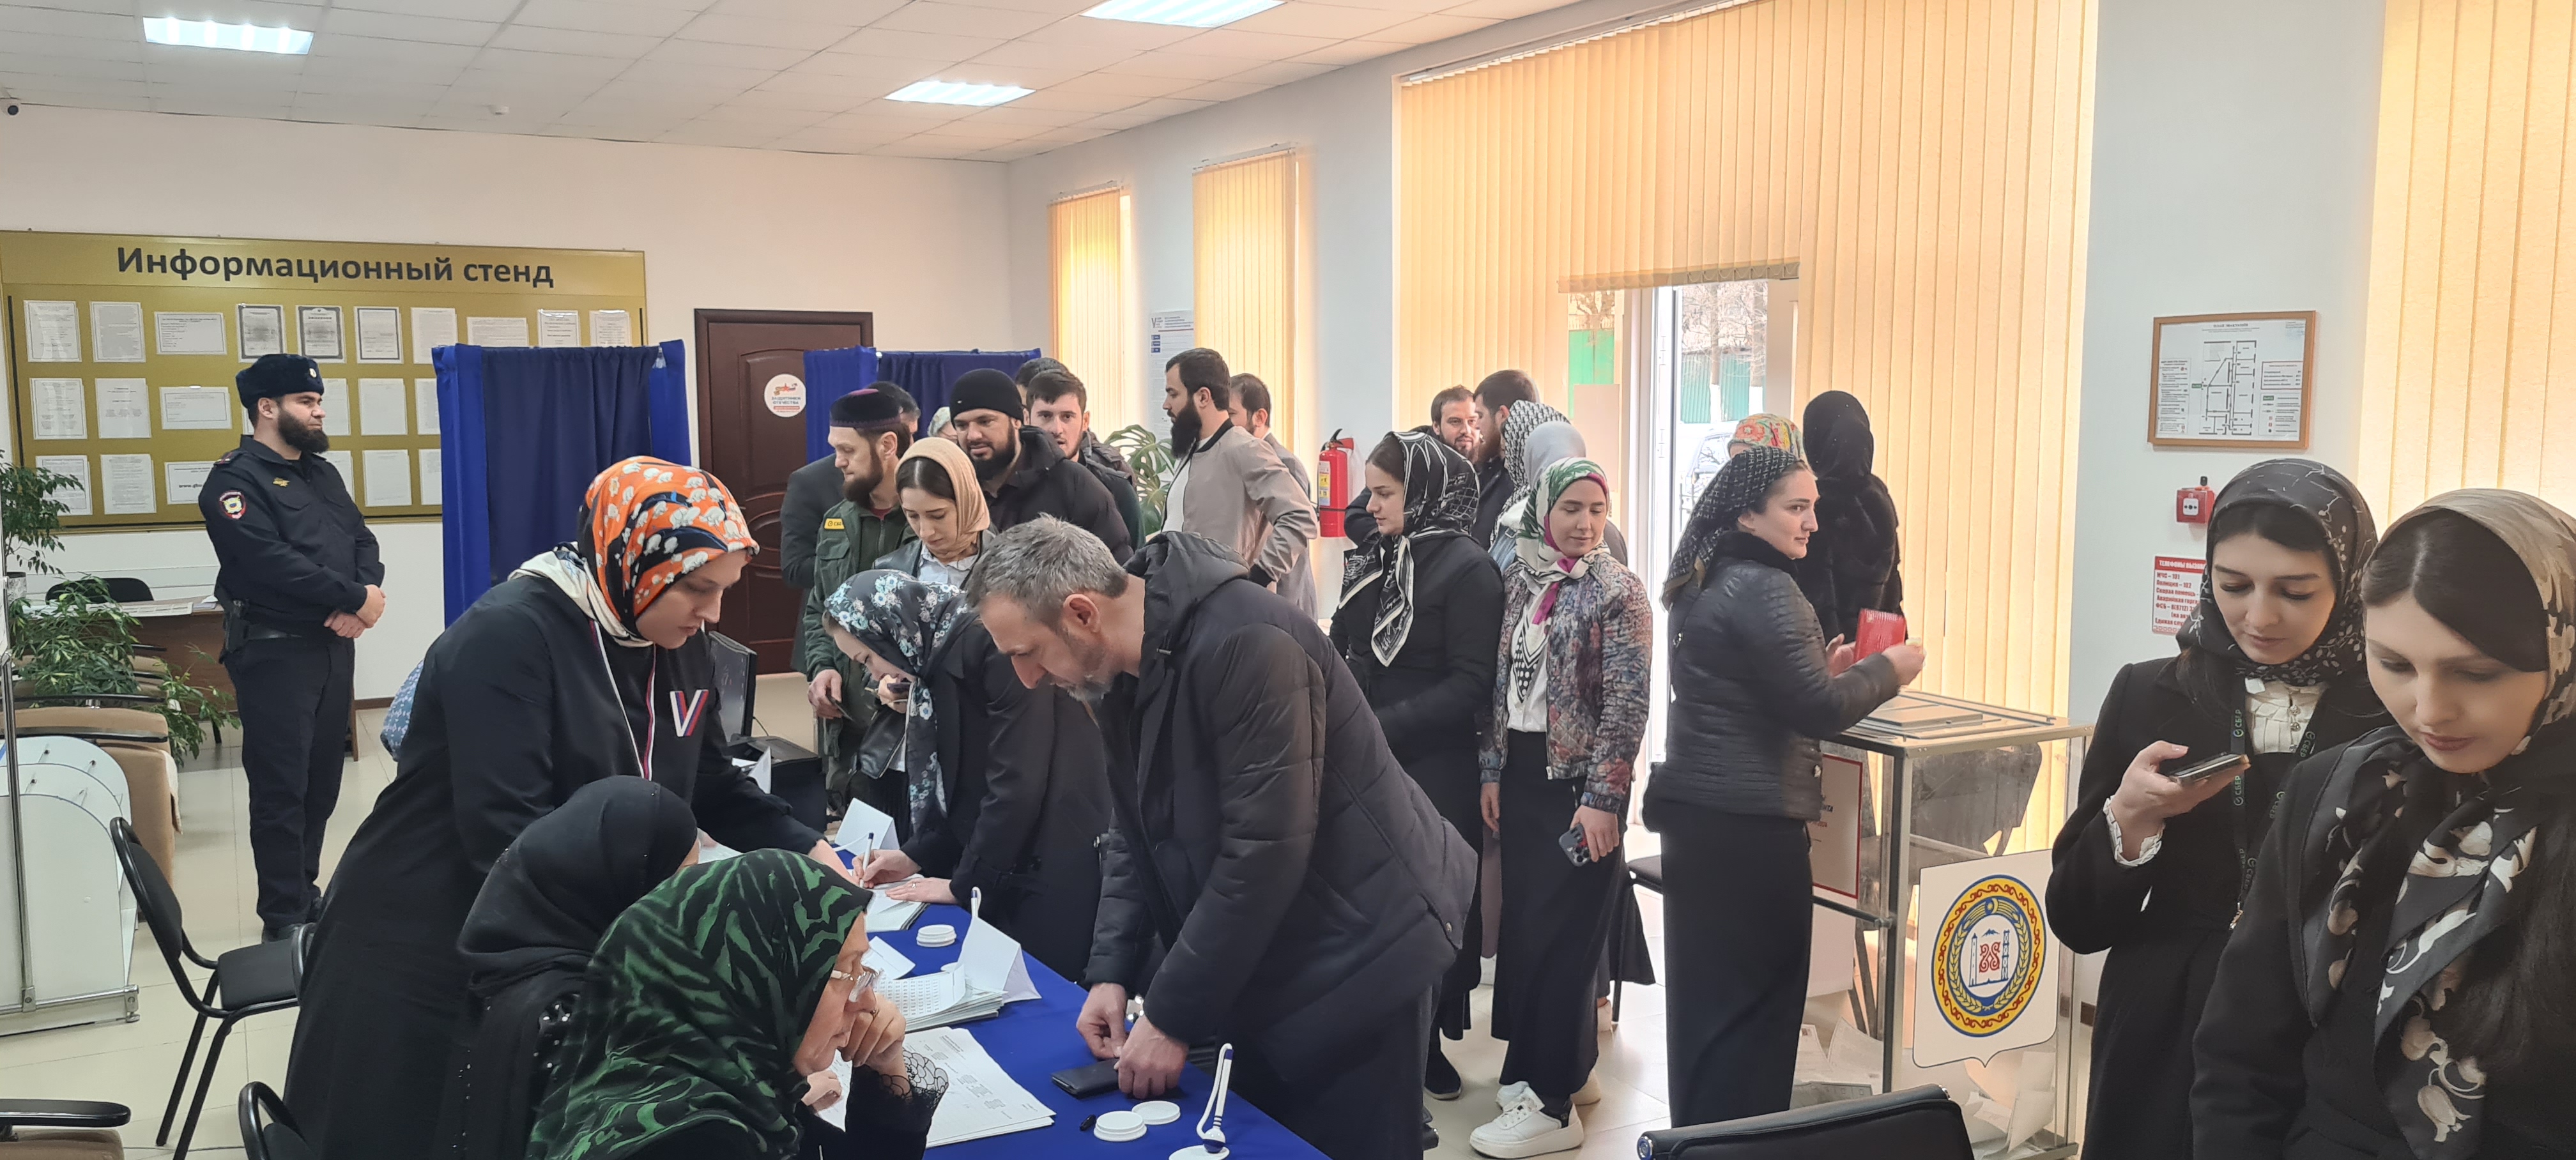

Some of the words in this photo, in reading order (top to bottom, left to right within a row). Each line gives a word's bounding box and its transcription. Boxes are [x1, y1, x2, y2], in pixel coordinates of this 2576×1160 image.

[118, 247, 452, 282] Информационный
[463, 263, 554, 287] стенд
[670, 689, 709, 737] V
[2299, 740, 2311, 758] СБЕР
